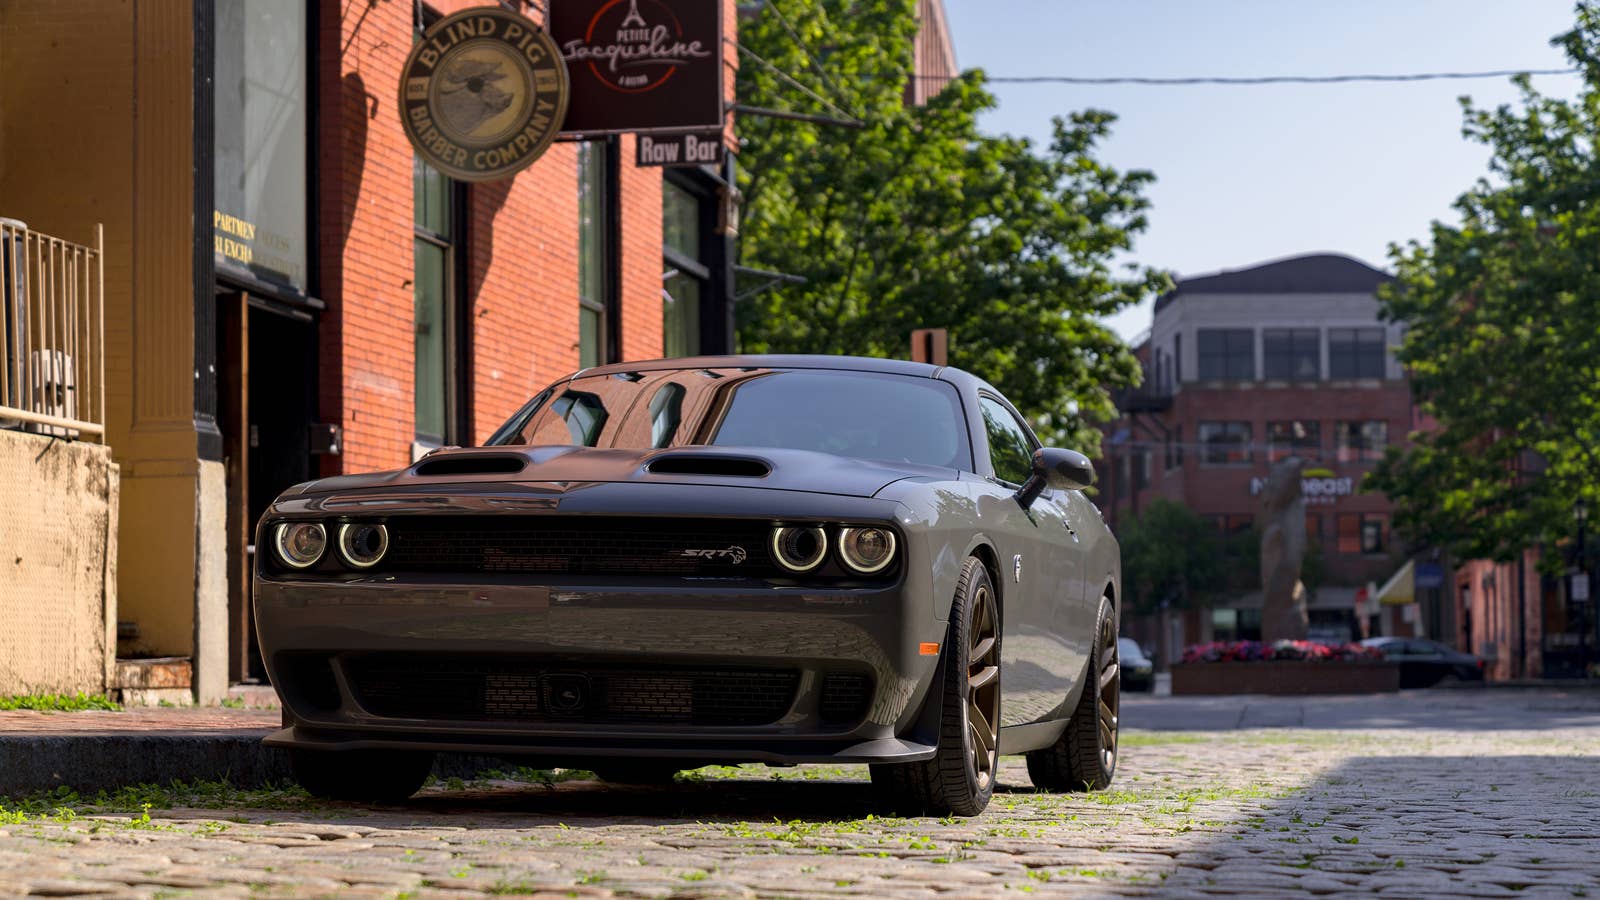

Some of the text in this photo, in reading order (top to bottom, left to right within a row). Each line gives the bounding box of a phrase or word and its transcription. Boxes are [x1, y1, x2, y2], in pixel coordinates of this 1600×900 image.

[418, 17, 546, 69] BLIND PIG
[560, 25, 711, 73] Jacqueline
[616, 28, 650, 42] PETITE
[410, 99, 555, 169] BARBER COMPANY
[641, 135, 718, 162] Raw Bar
[214, 210, 256, 240] PARTMEN
[681, 549, 733, 559] SRT
